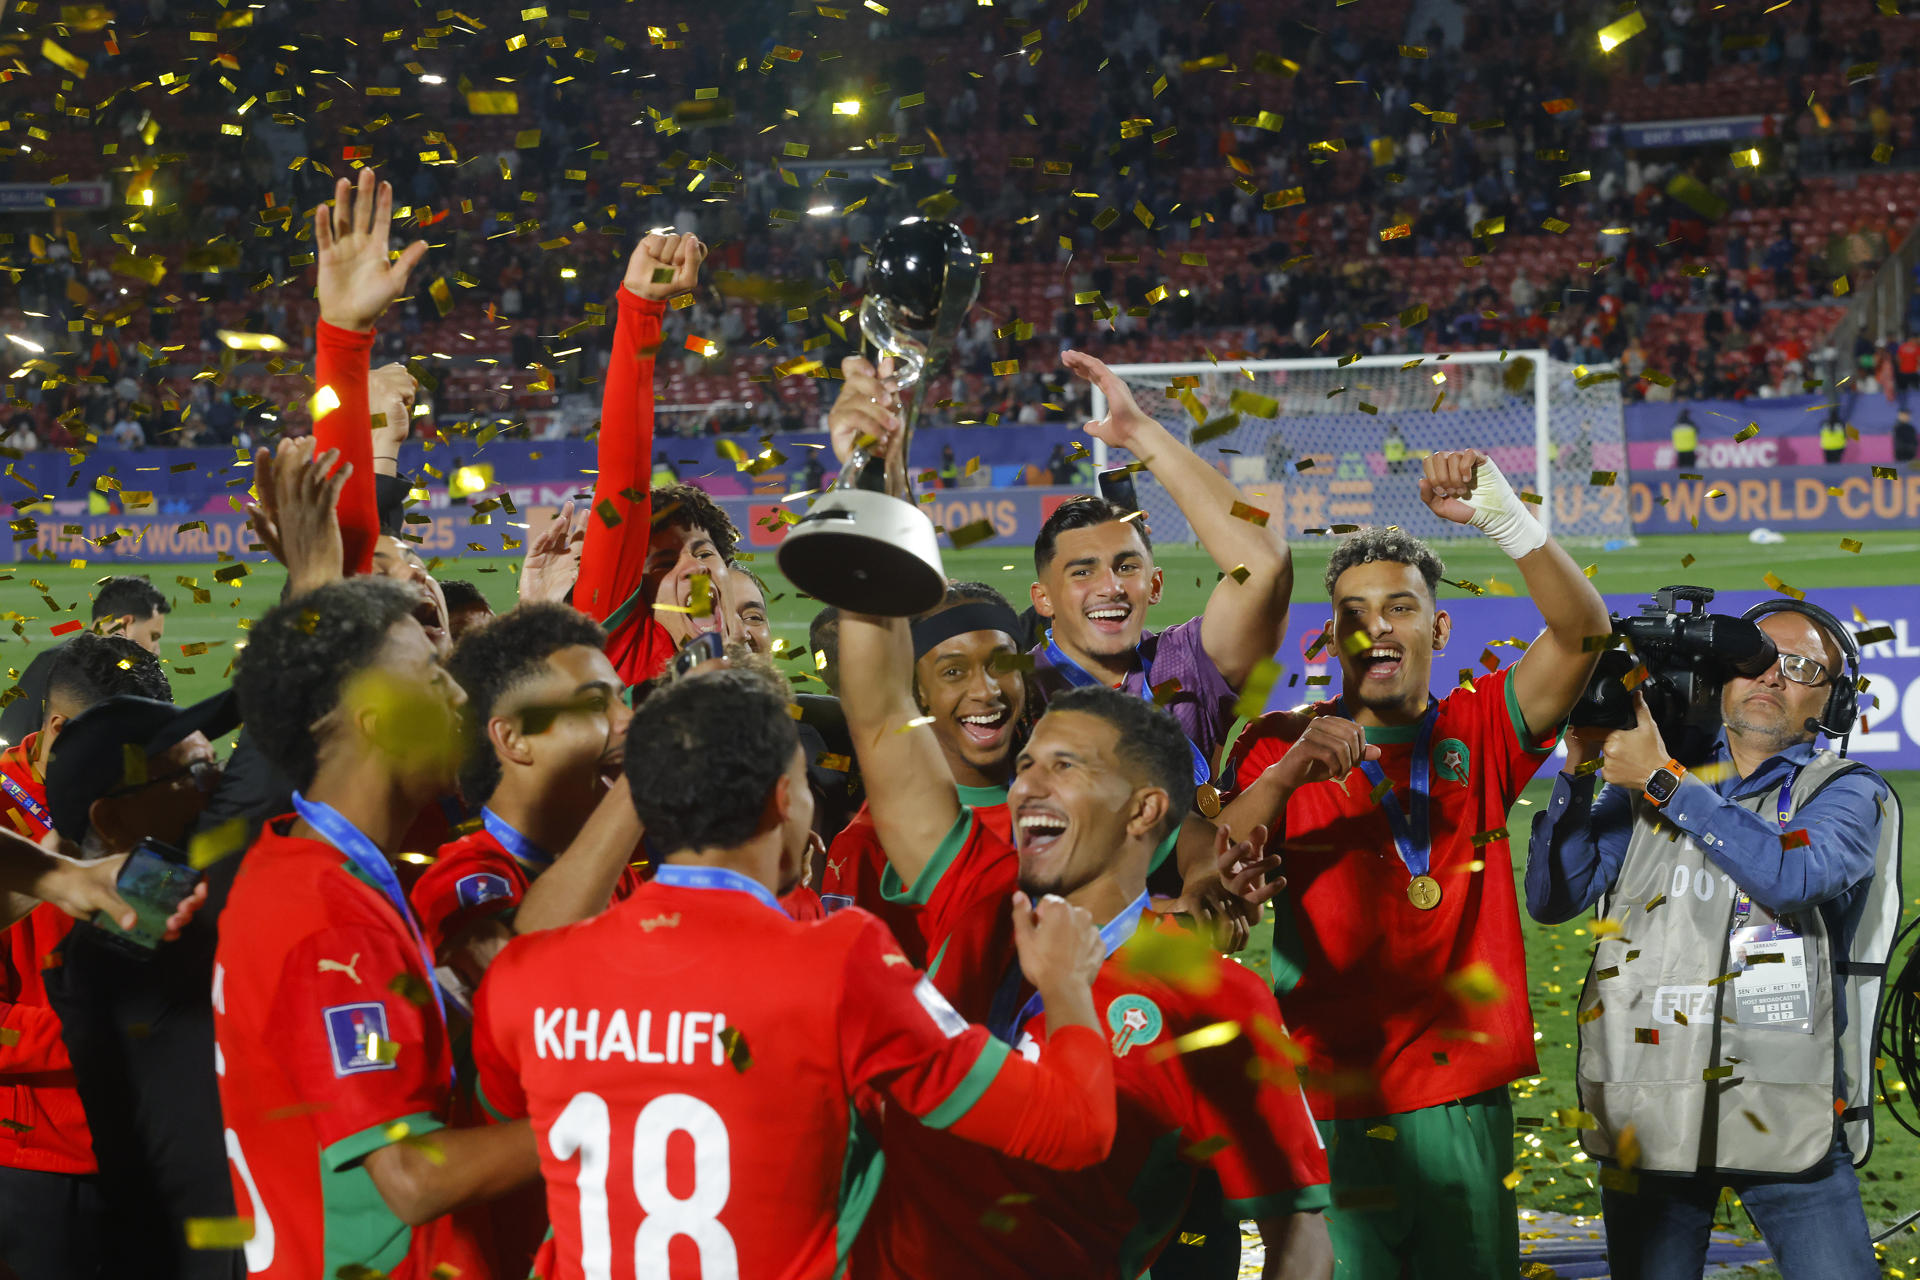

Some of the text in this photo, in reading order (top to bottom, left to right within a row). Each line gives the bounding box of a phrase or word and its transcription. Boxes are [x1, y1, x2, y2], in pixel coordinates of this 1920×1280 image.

[1654, 442, 1777, 471] #20WC
[1661, 478, 1829, 523] WORLD
[147, 521, 232, 554] WORLD
[1661, 992, 1716, 1017] FIFA
[534, 1007, 726, 1067] KHALIFI
[548, 1091, 740, 1280] 18
